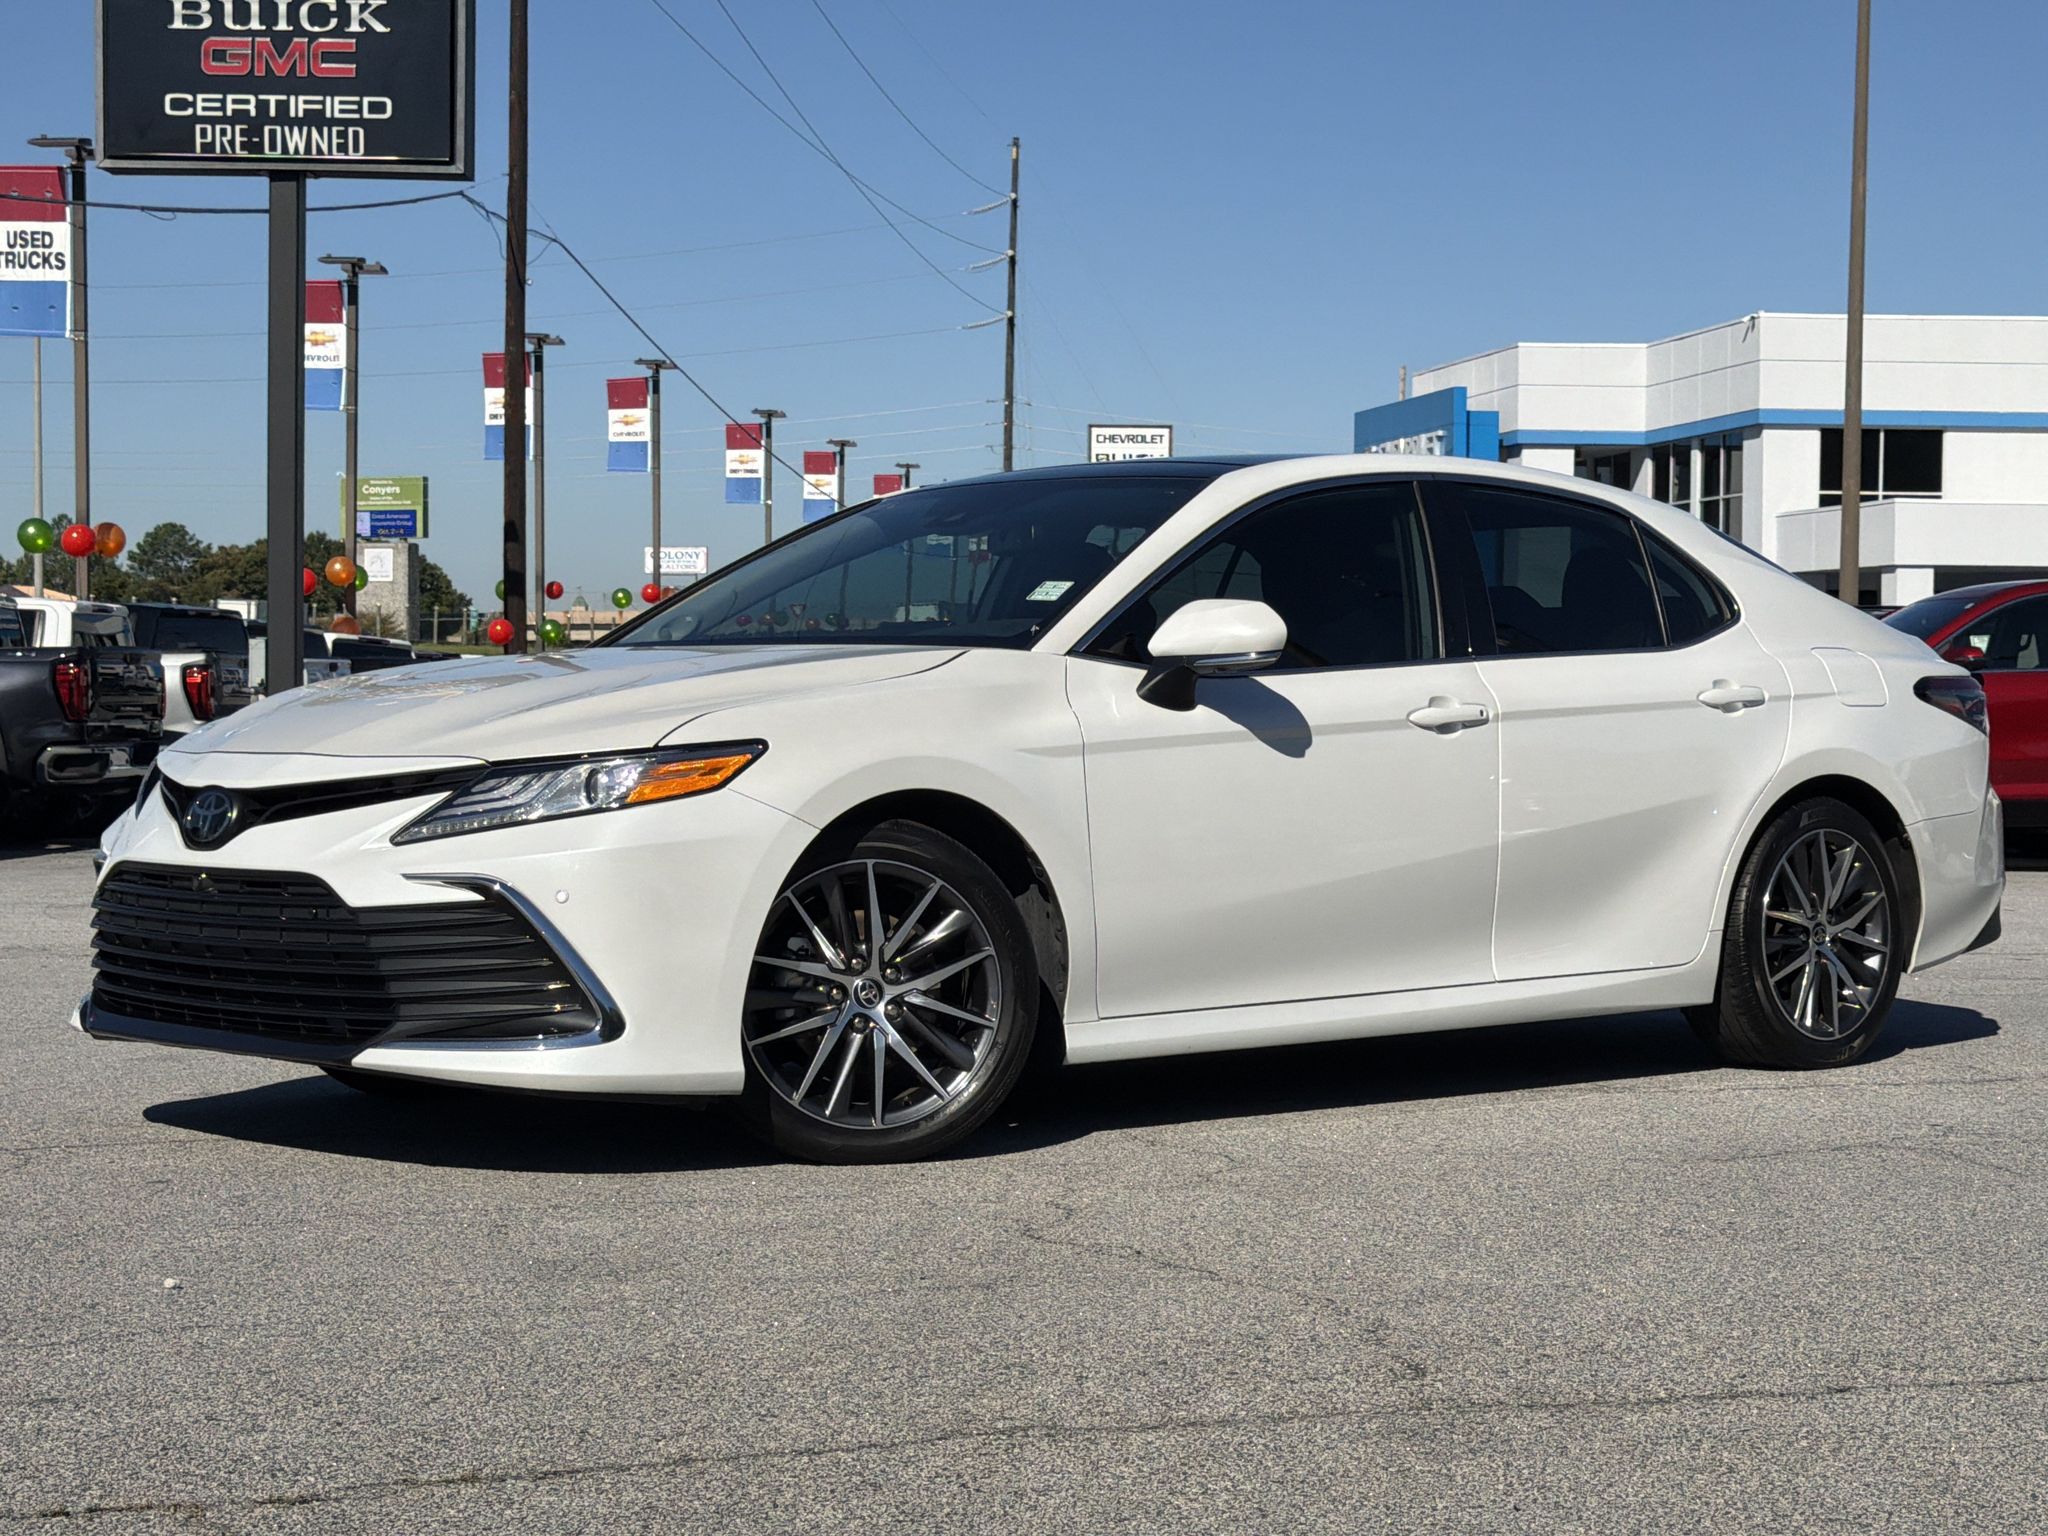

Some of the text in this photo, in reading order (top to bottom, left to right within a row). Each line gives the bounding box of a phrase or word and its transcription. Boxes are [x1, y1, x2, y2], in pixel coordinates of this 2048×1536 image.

[167, 0, 391, 33] BUICK
[200, 36, 357, 78] GMC
[164, 92, 393, 120] CERTIFIED
[194, 123, 366, 157] PRE-OWNED
[6, 229, 54, 250] USED
[304, 354, 341, 363] EVROLET
[1096, 434, 1165, 444] CHEVROLET
[362, 484, 401, 495] Conyers
